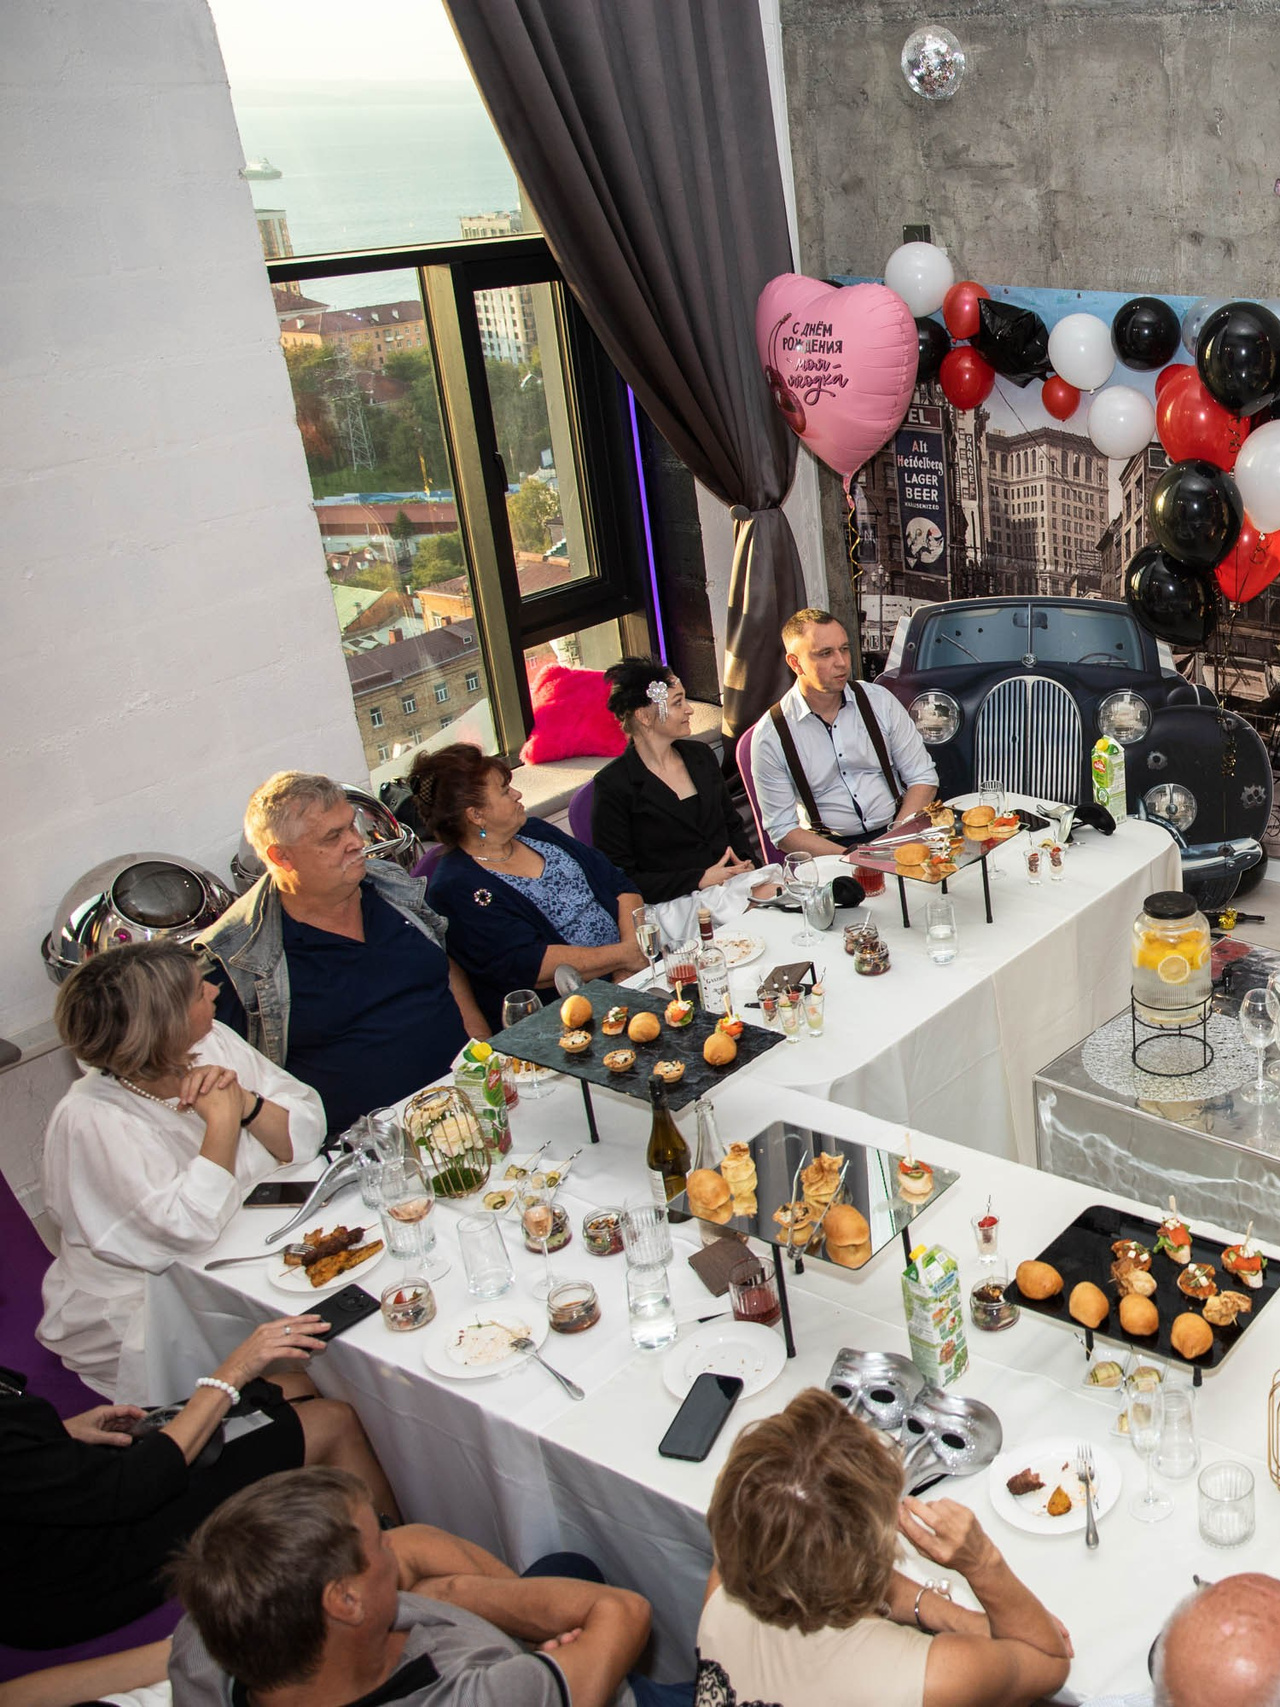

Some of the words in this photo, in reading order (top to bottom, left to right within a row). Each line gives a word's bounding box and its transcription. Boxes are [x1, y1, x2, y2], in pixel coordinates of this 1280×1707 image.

[792, 321, 801, 335] С
[801, 320, 833, 337] ДНЁМ
[911, 440, 929, 454] Alt
[897, 454, 944, 477] Heidelberg
[904, 472, 939, 487] LAGER
[905, 486, 939, 502] BEER
